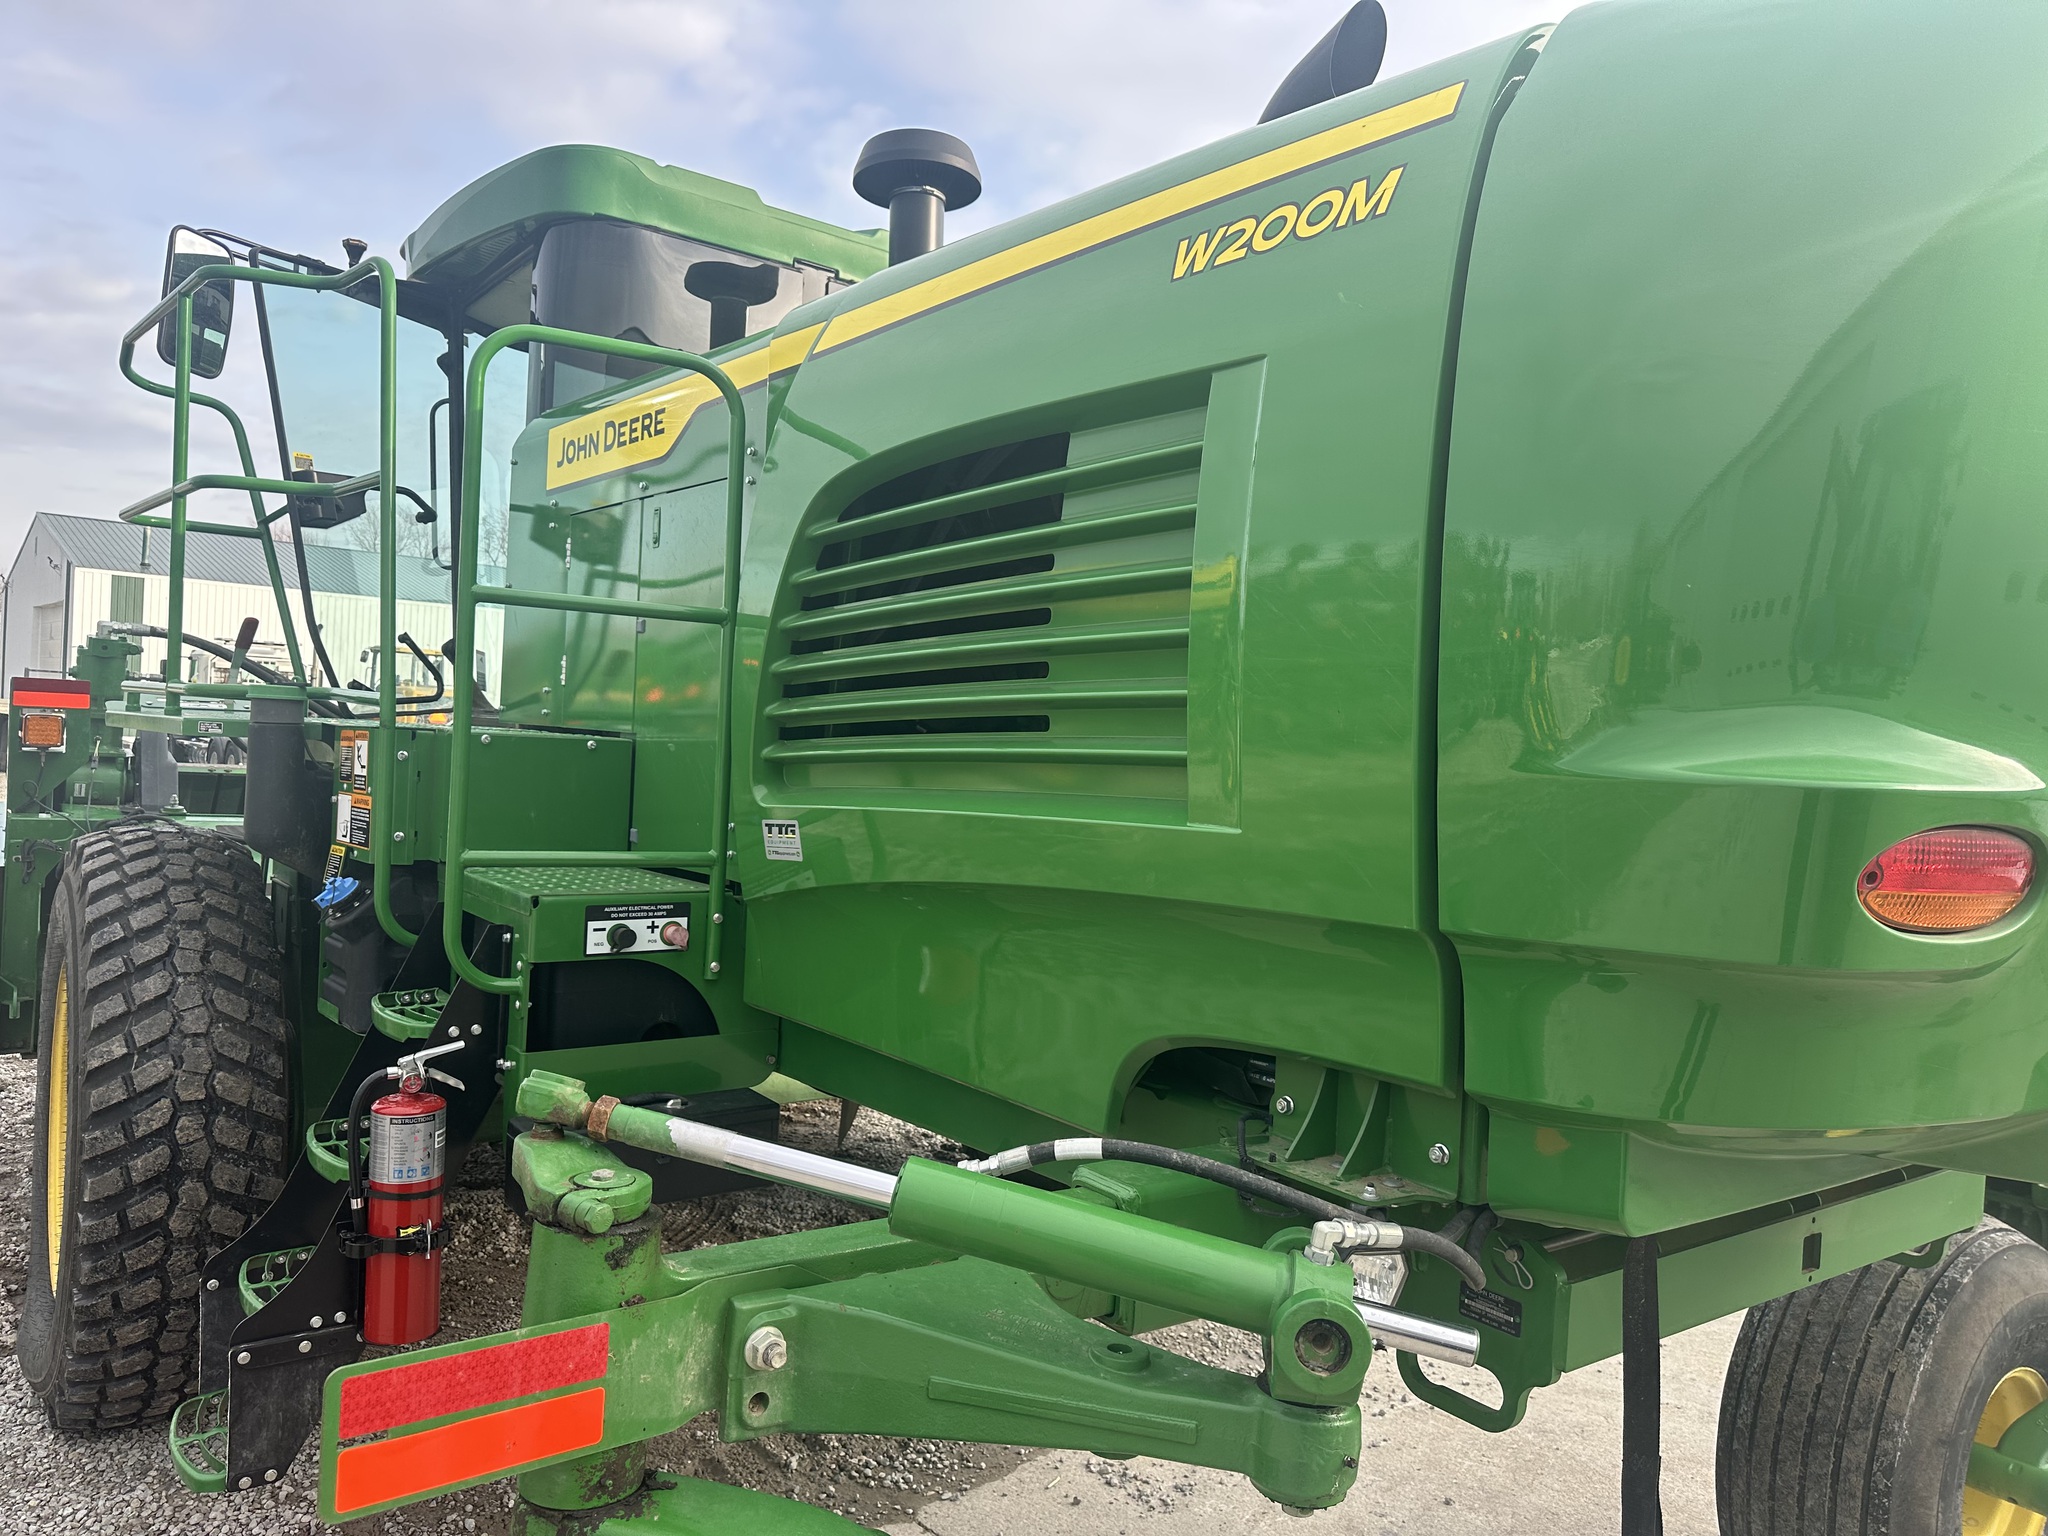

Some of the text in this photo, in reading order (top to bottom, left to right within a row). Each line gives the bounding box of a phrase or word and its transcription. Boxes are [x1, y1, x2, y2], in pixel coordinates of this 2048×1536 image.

[1171, 163, 1407, 282] W200M
[556, 407, 666, 468] JOHN DEERE
[765, 823, 796, 839] TTG
[391, 1116, 434, 1124] INSTRUCTIONS
